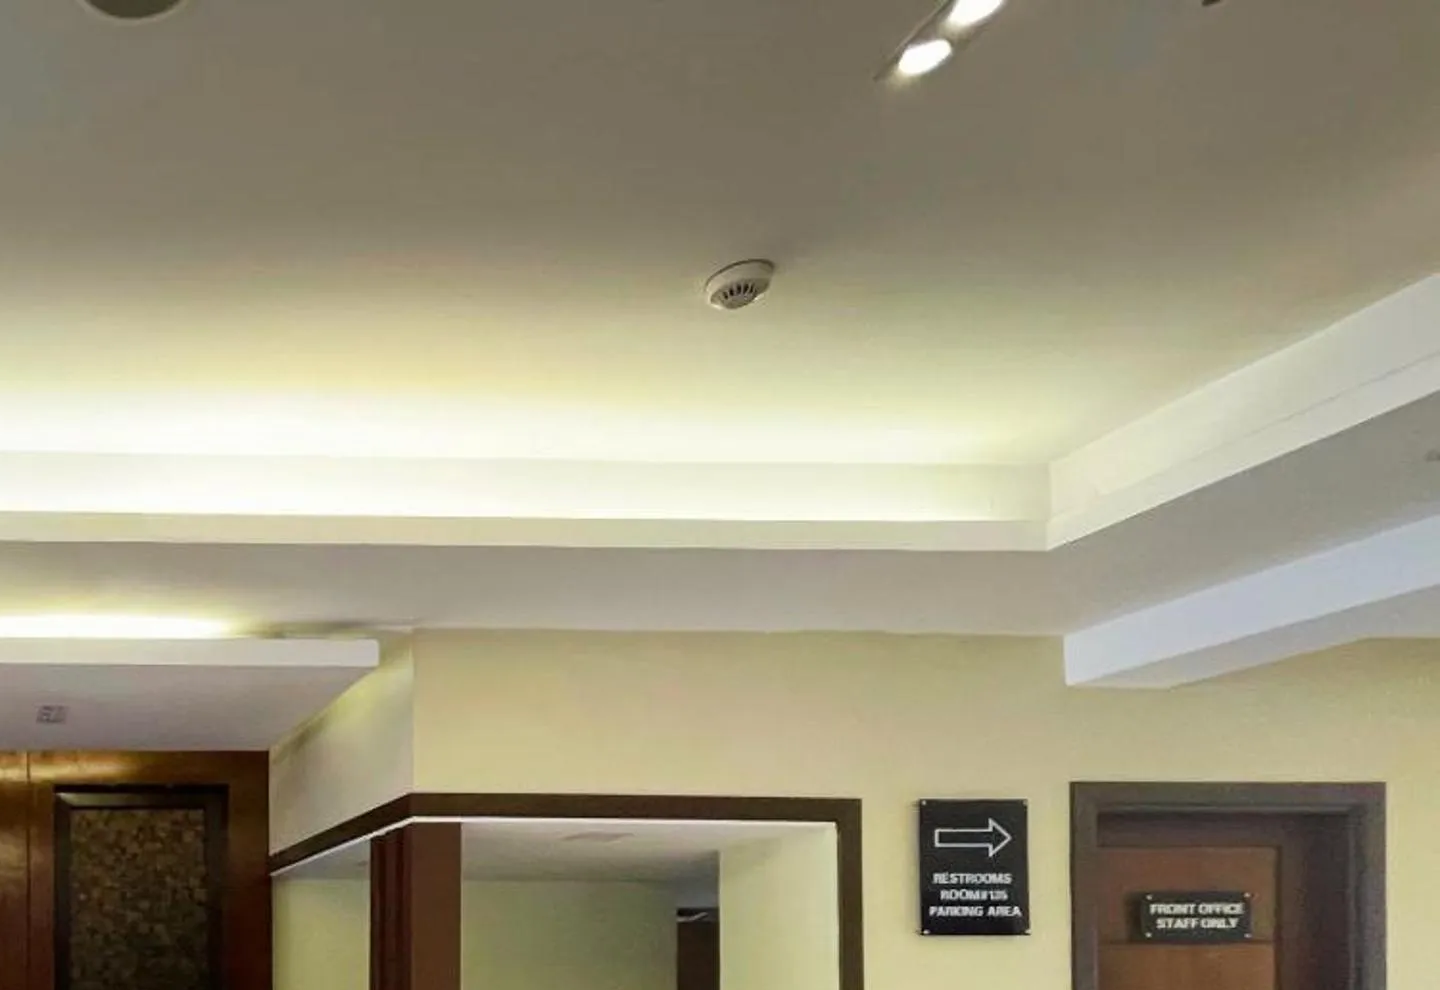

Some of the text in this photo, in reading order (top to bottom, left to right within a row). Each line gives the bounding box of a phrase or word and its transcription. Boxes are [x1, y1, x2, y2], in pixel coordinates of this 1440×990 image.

[932, 872, 1012, 884] RESTROOMS
[928, 905, 1023, 917] PARKING AREA
[1149, 902, 1245, 915] FRONT OFFICE
[1155, 917, 1239, 929] STAFF ONLY
